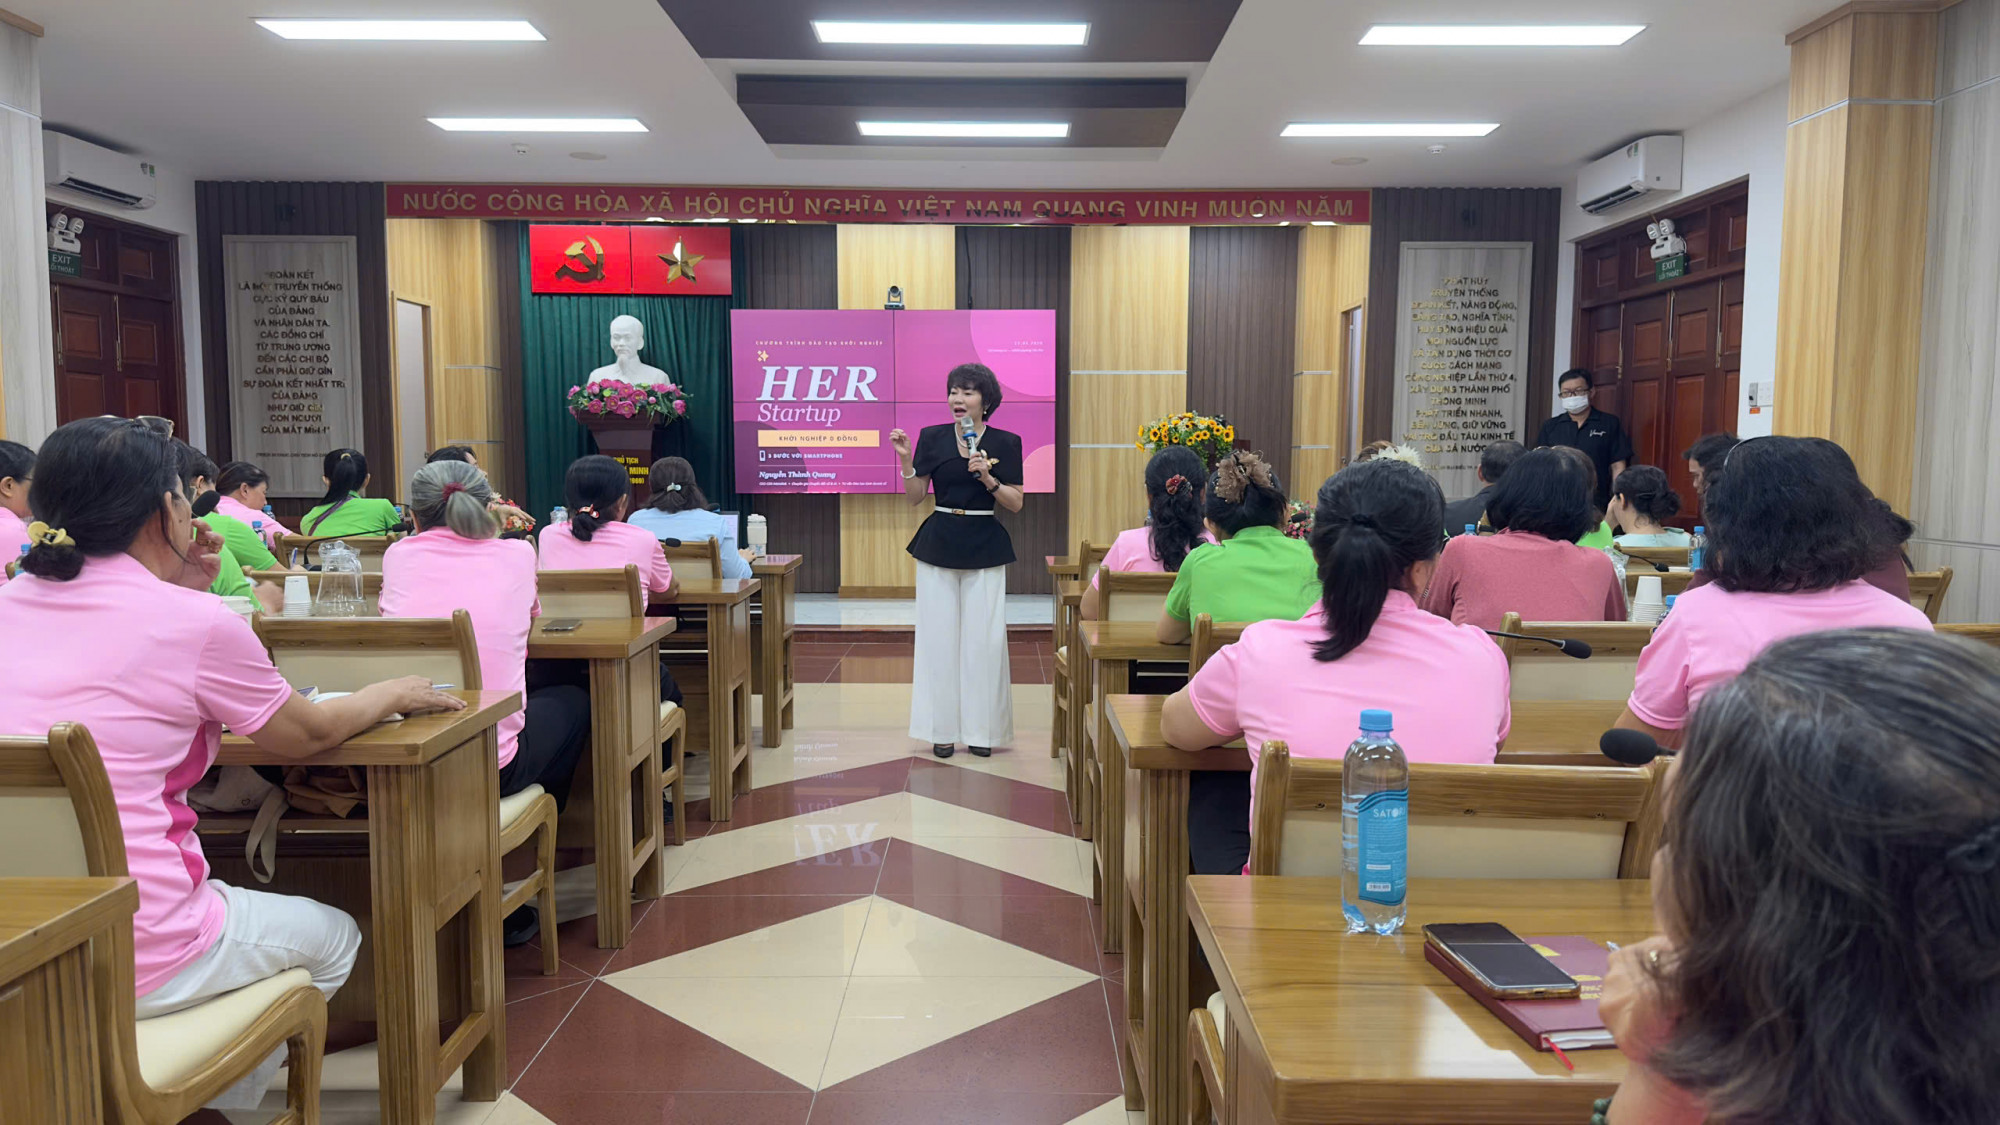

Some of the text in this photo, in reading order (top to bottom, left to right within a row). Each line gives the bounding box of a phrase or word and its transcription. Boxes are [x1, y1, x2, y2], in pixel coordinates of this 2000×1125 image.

[403, 188, 1353, 220] NƯỚC CỘNG HÒA XÃ HỘI CHỦ NGHĨA VIỆT NAM QUANG VINH MUÔN NĂM
[52, 254, 72, 264] EXIT
[1662, 260, 1677, 270] EXIT
[296, 269, 314, 278] KẾT
[269, 305, 287, 314] CỦA
[299, 355, 314, 363] CHI
[756, 366, 878, 400] HER
[270, 414, 289, 422] CON
[758, 403, 841, 427] Startup
[629, 467, 649, 475] MINH
[759, 470, 836, 479] Nguyễn Thành Quang
